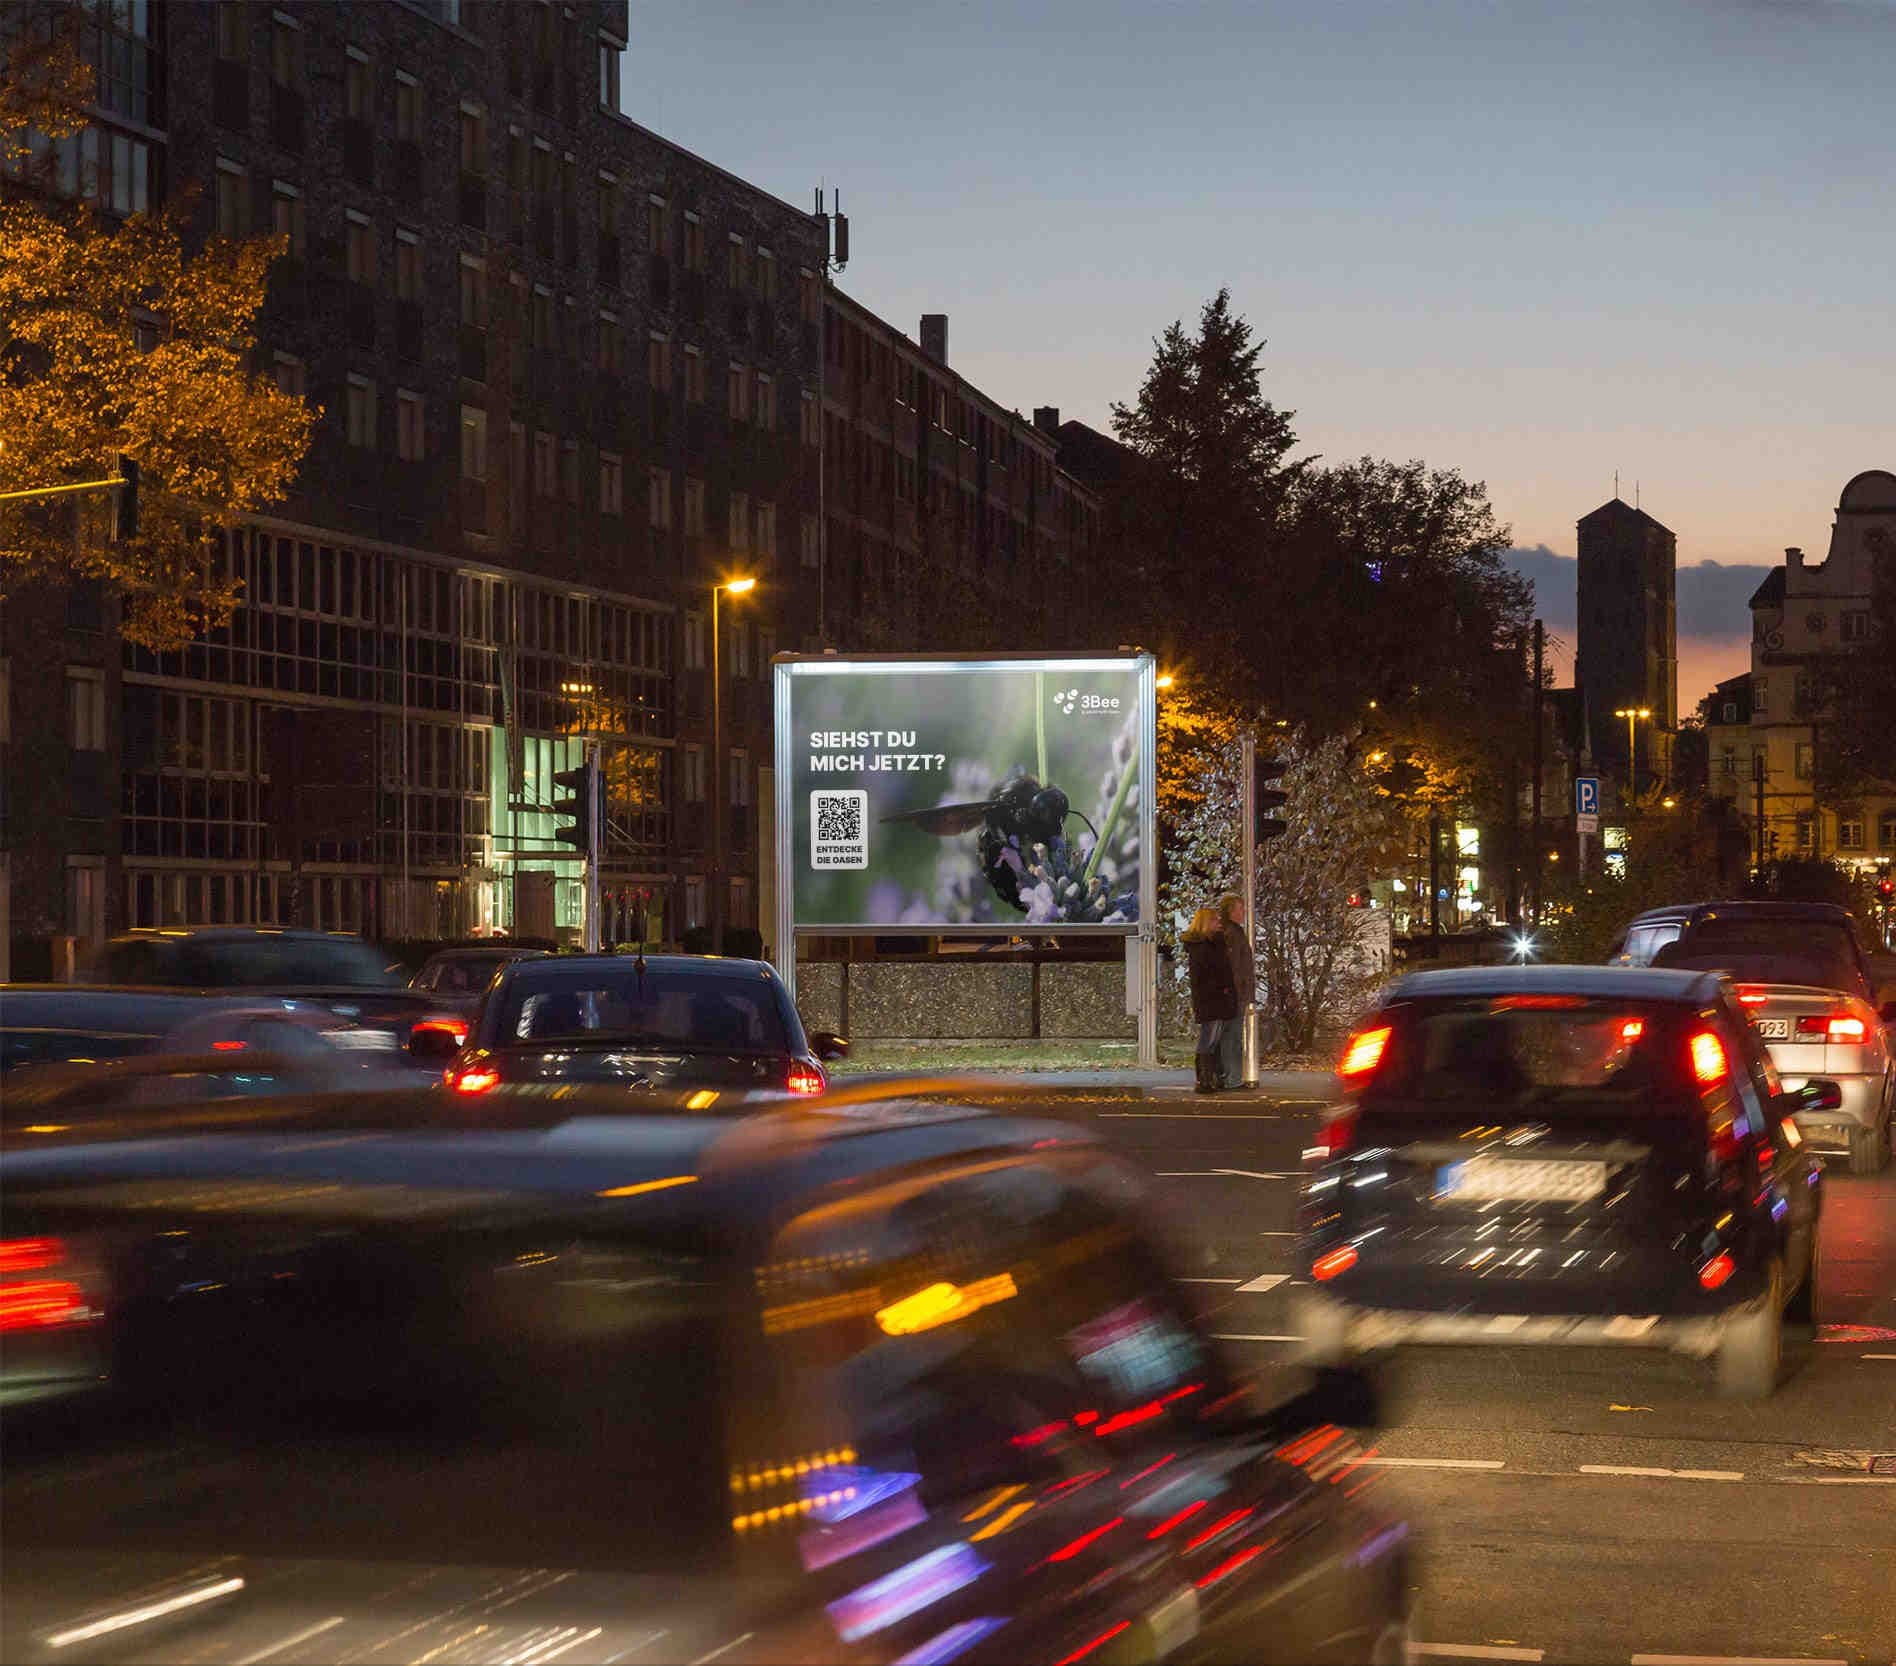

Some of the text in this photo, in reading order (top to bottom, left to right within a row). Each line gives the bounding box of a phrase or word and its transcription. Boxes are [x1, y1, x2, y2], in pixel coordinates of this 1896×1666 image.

[1081, 695, 1119, 708] 3Bee
[810, 731, 916, 747] SIEHST DU
[810, 754, 946, 771] MICH JETZT?
[1581, 784, 1593, 811] P
